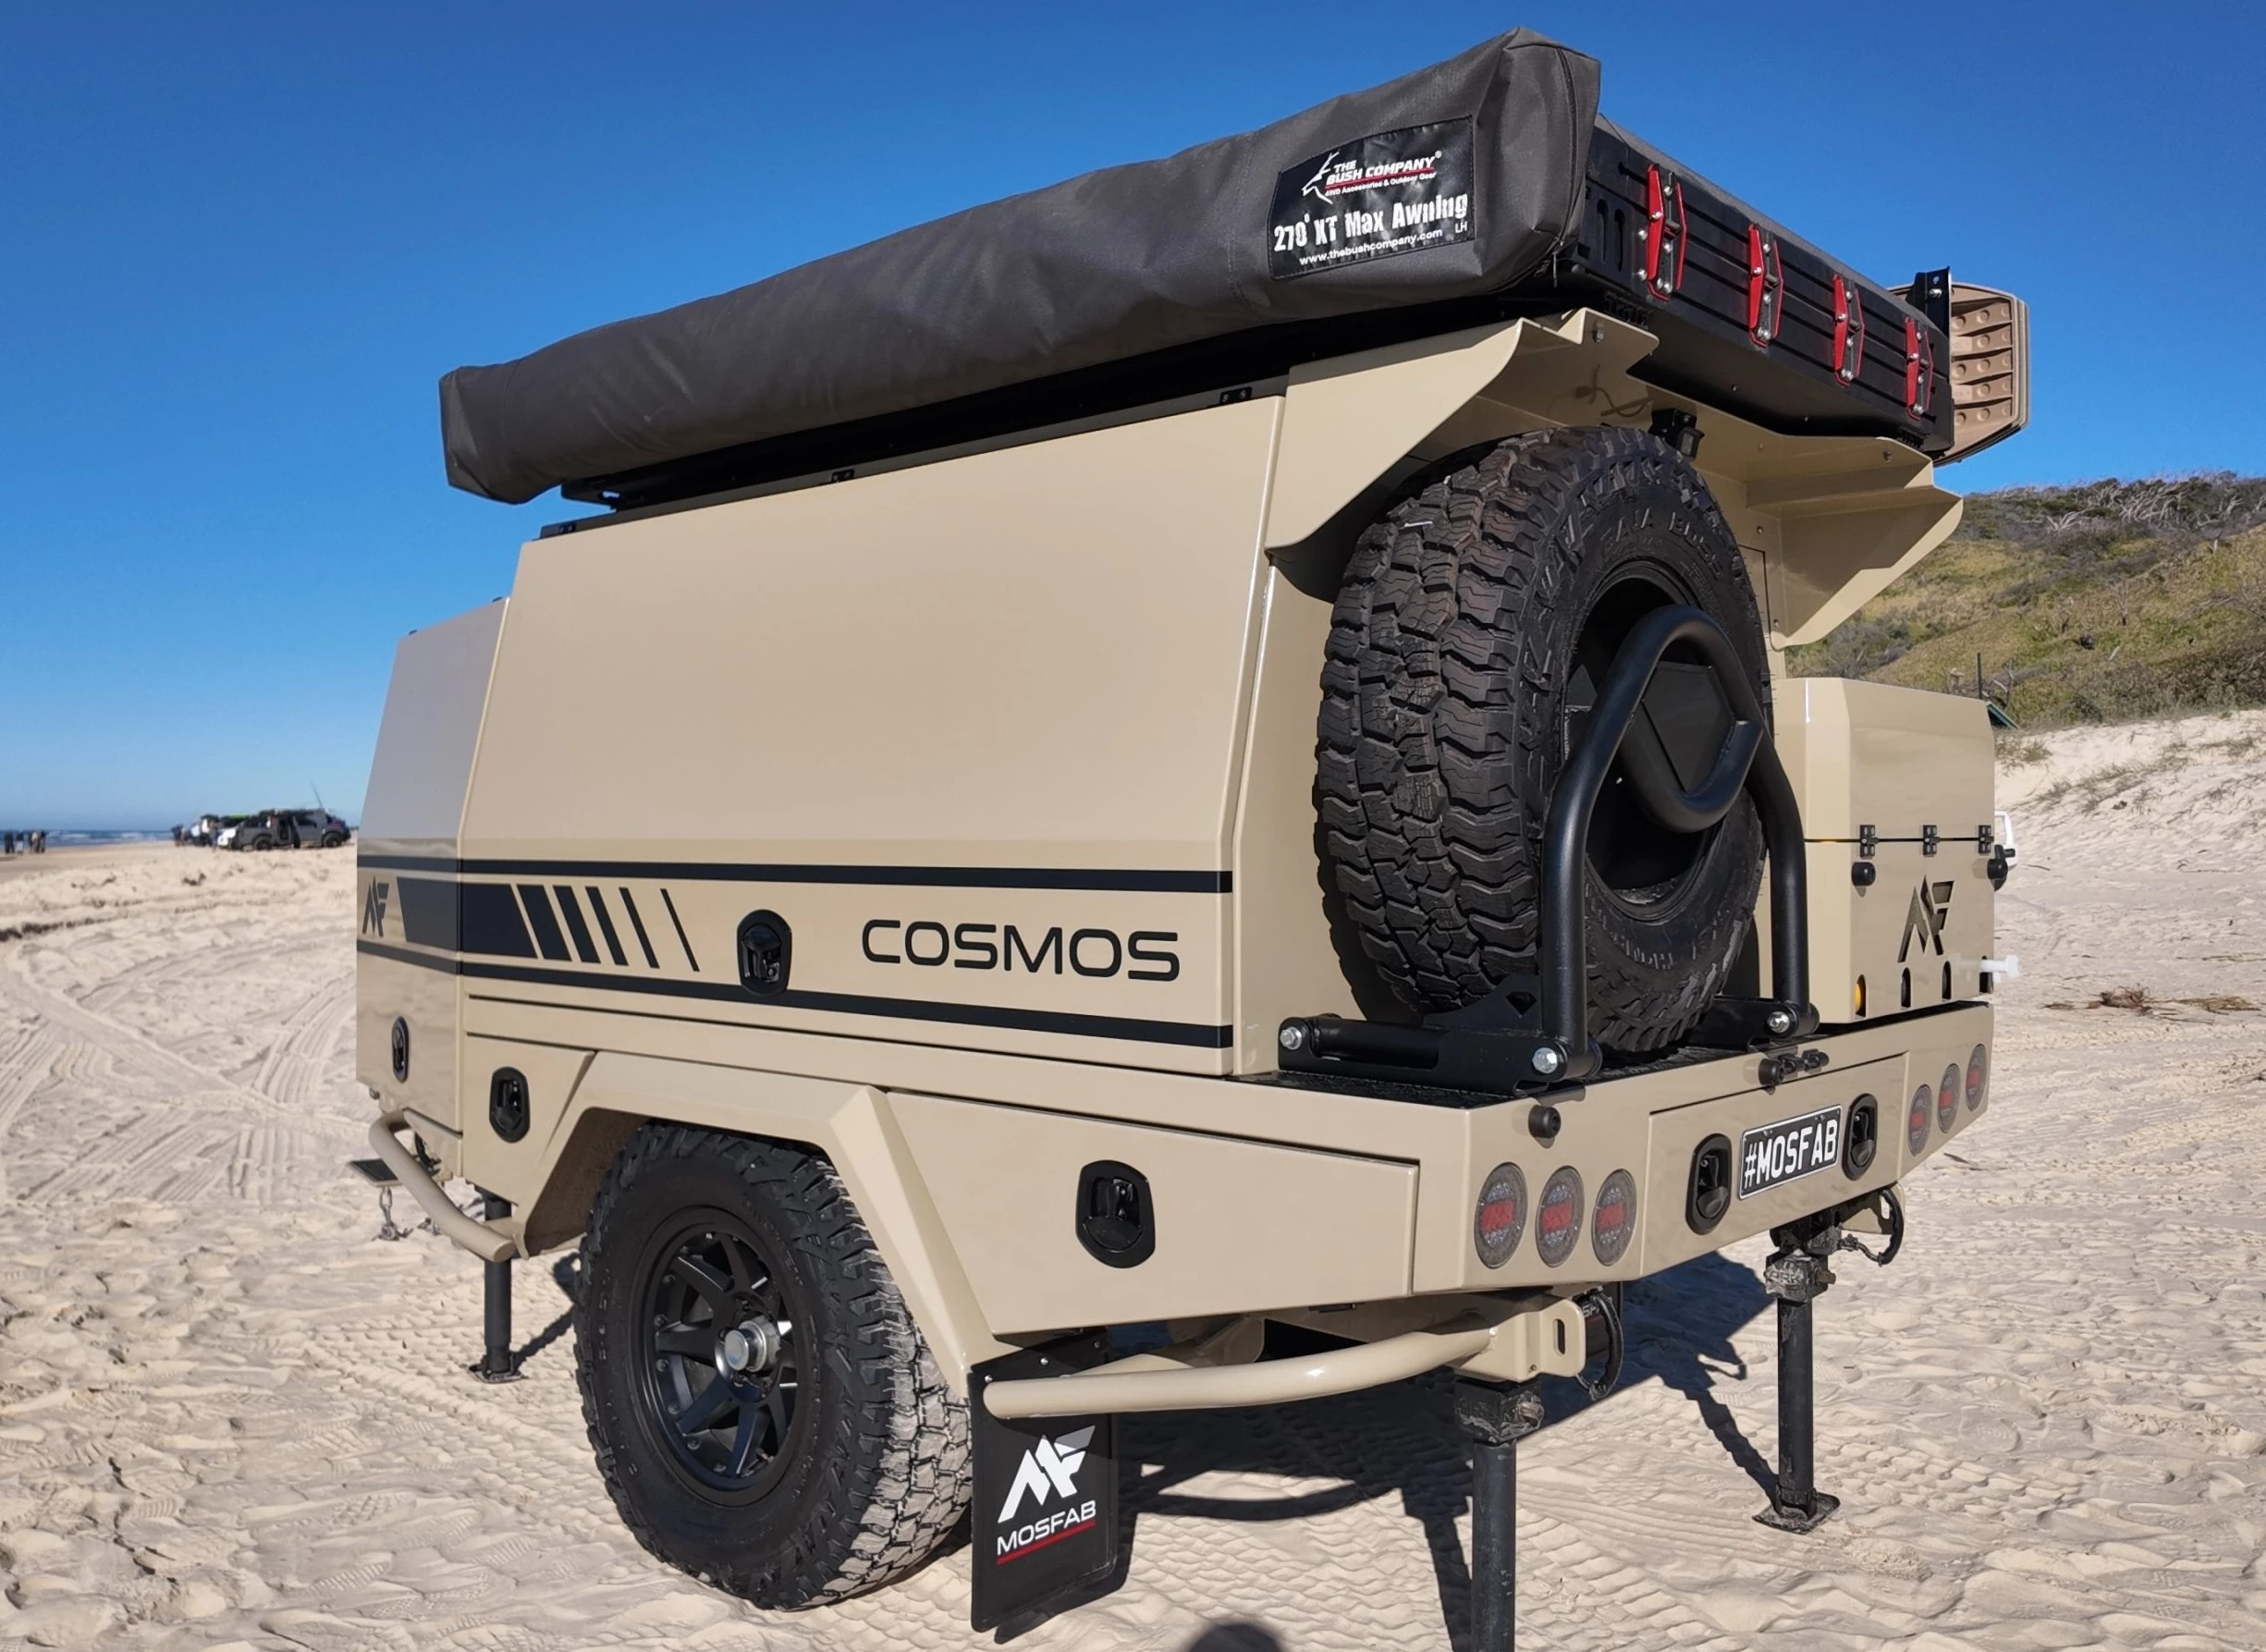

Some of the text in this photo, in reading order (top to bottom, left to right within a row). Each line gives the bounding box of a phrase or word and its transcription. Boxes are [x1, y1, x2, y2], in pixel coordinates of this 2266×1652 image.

[1326, 168, 1363, 185] BUSH
[1333, 160, 1357, 173] THE
[1314, 215, 1339, 246] XT
[1344, 210, 1384, 239] Max
[1391, 194, 1468, 229] Awning
[1454, 220, 1468, 234] LH
[1299, 229, 1443, 264] www.thebushcompany.com
[862, 919, 1181, 982] COSMOS
[1744, 1119, 1838, 1190] #MOSFAB
[996, 1499, 1096, 1556] MOSFAB
